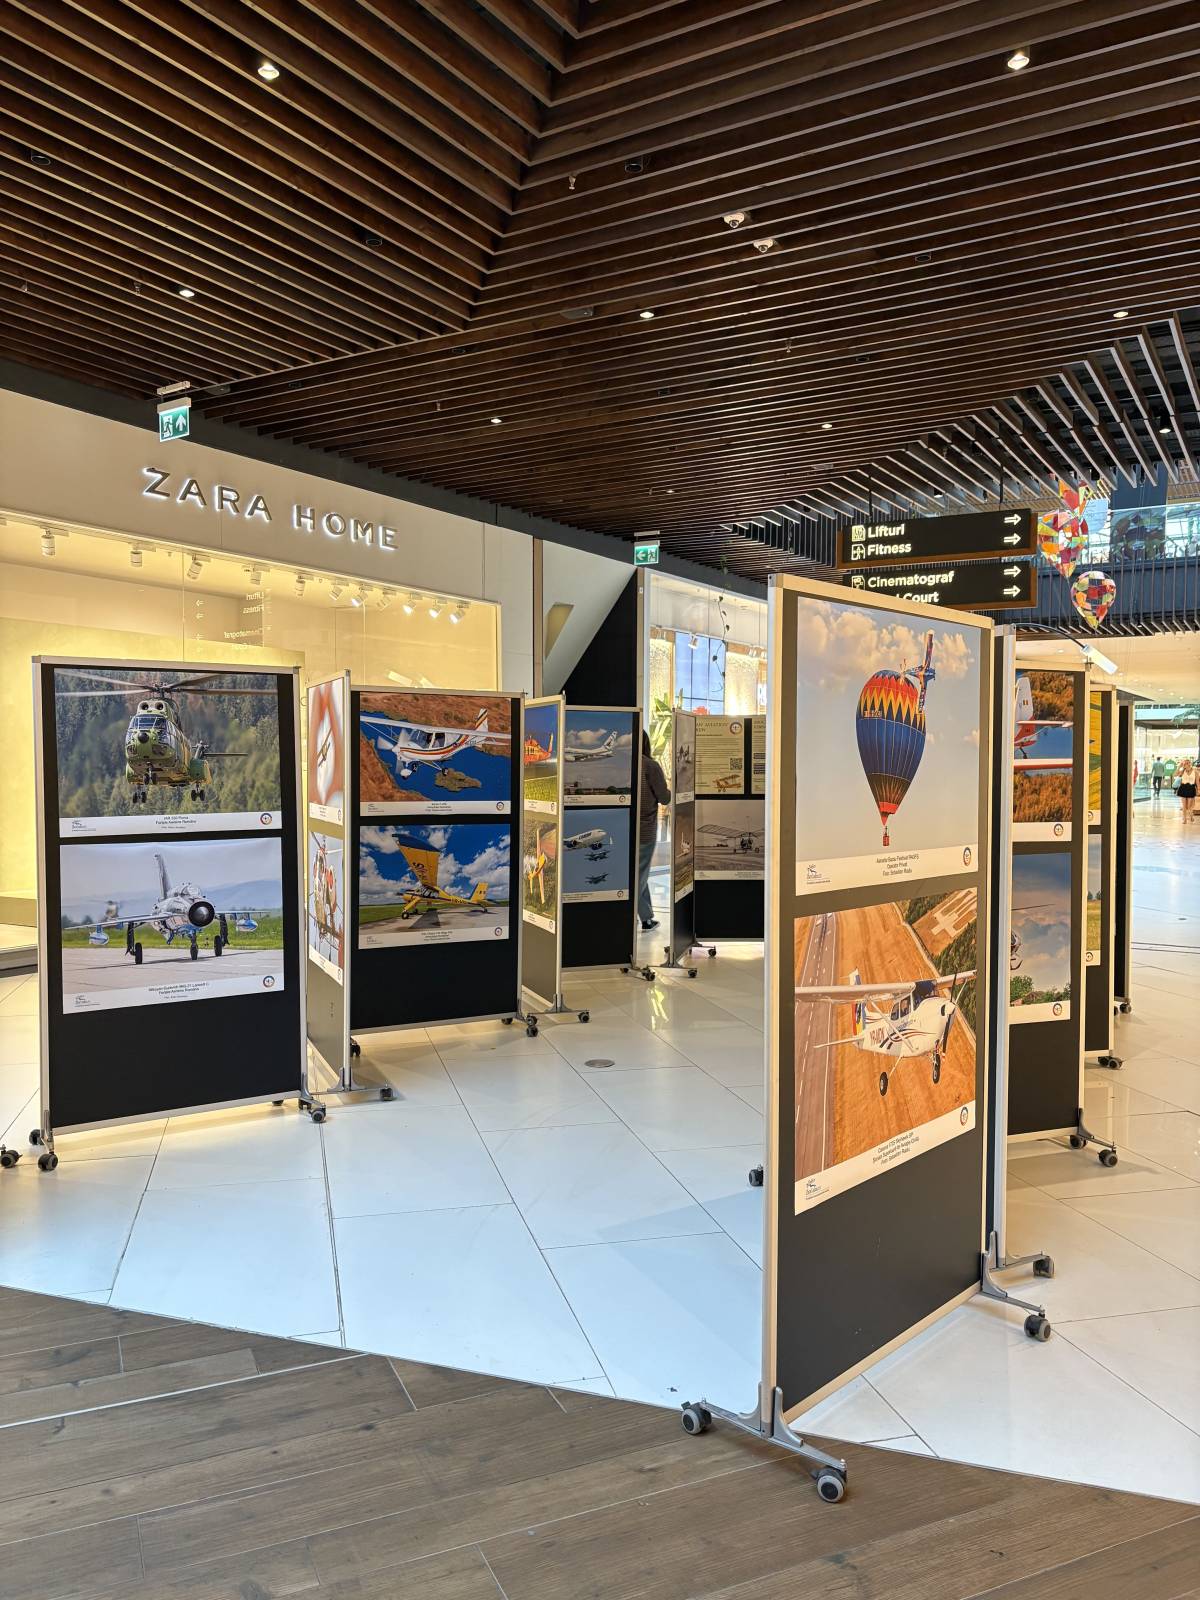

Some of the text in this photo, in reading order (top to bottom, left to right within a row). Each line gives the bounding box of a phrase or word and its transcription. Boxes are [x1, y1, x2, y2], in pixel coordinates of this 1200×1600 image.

[142, 467, 399, 551] ZARA HOME
[867, 523, 905, 538] Lifturi
[867, 543, 912, 556] Fitness
[867, 570, 955, 588] Cinematograf
